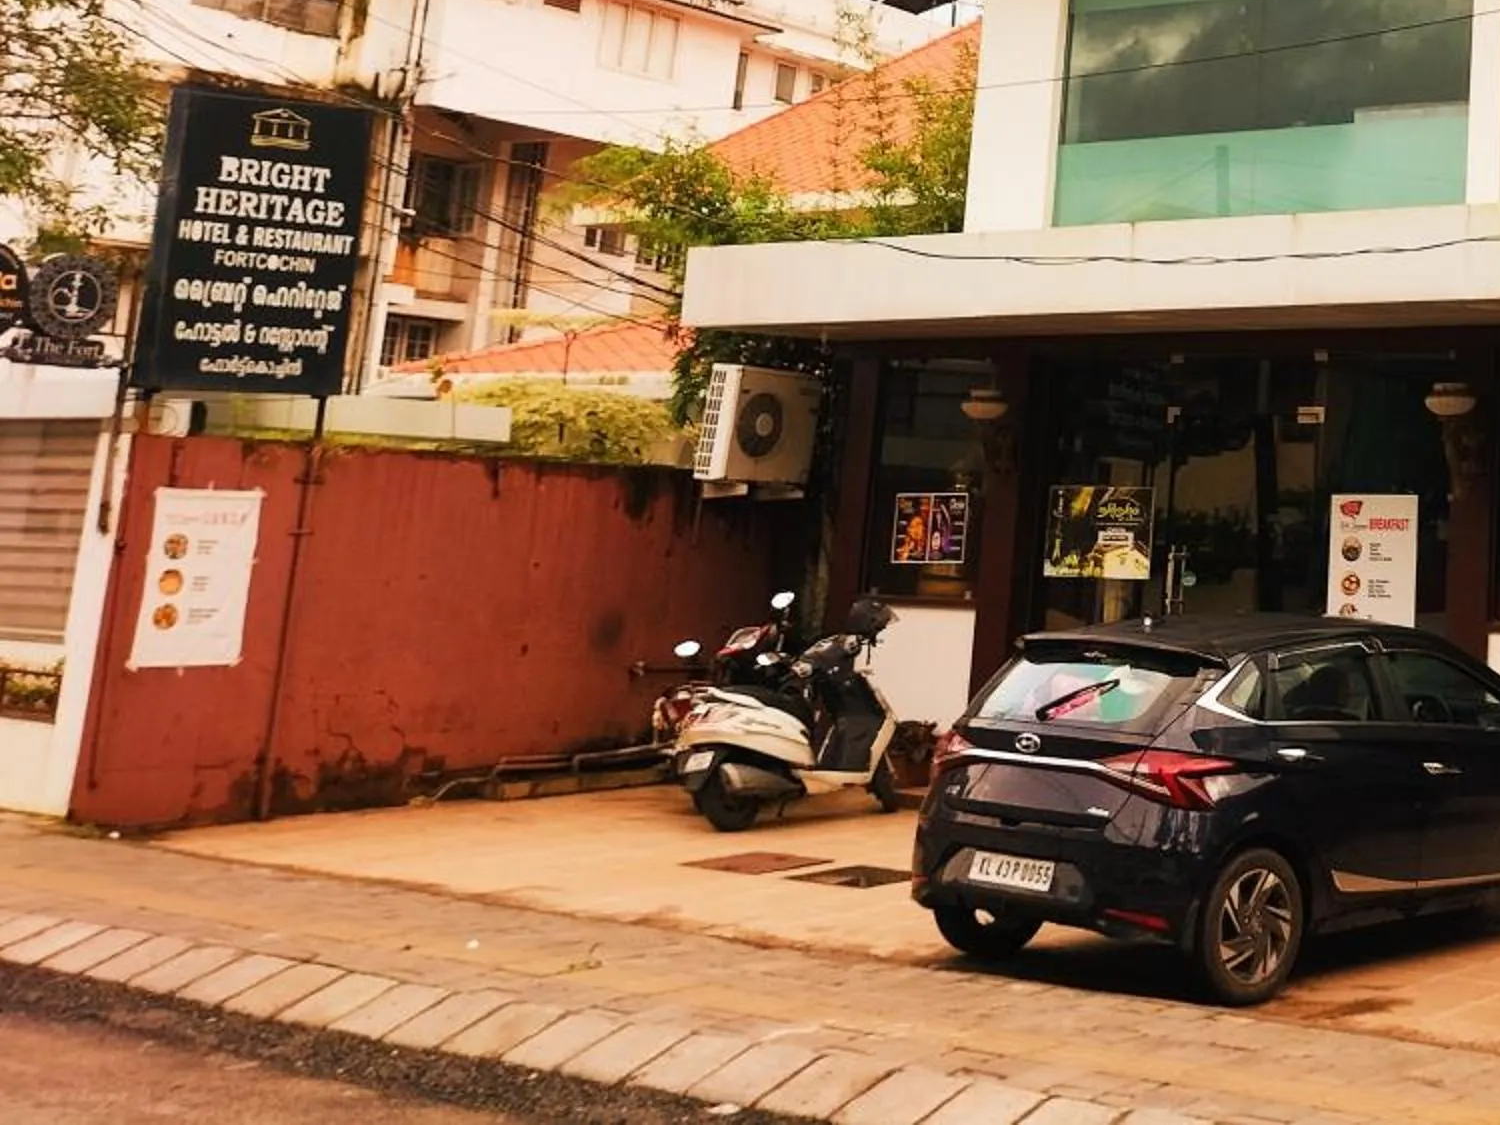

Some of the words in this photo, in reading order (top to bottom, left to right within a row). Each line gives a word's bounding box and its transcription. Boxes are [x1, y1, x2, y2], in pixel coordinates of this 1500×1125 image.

[218, 155, 332, 194] BRIGHT
[193, 186, 346, 228] HERITAGE
[178, 218, 232, 244] HOTEL
[235, 224, 250, 246] &
[253, 226, 356, 255] RESTAURANT
